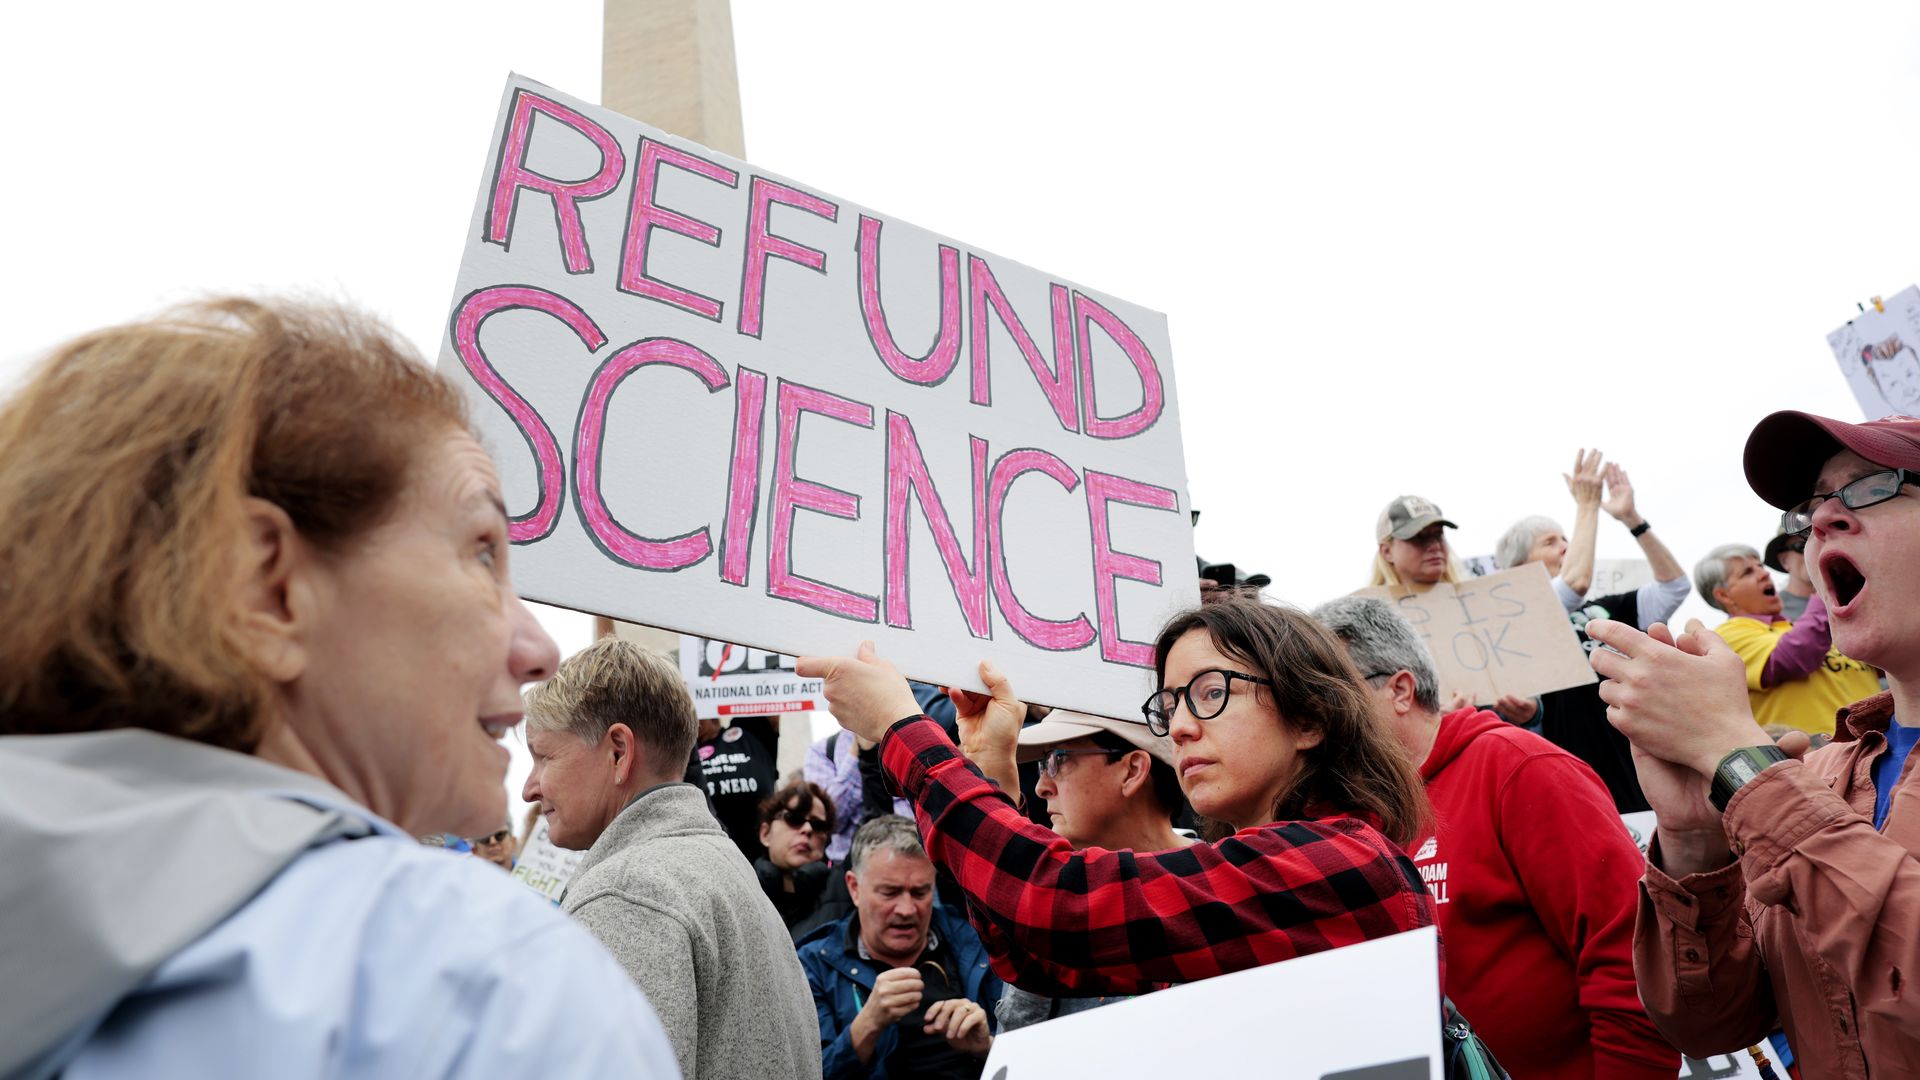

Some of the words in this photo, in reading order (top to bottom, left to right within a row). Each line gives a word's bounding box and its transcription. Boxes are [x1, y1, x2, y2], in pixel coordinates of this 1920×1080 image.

[483, 87, 1165, 439] REFUND
[451, 284, 1179, 668] SCIENCE
[1450, 582, 1526, 626] IS
[1452, 622, 1532, 671] OK
[695, 686, 752, 699] NATIONAL
[756, 684, 780, 696] DAY
[783, 683, 797, 694] OF
[801, 681, 823, 694] ACT
[719, 777, 758, 795] NERO
